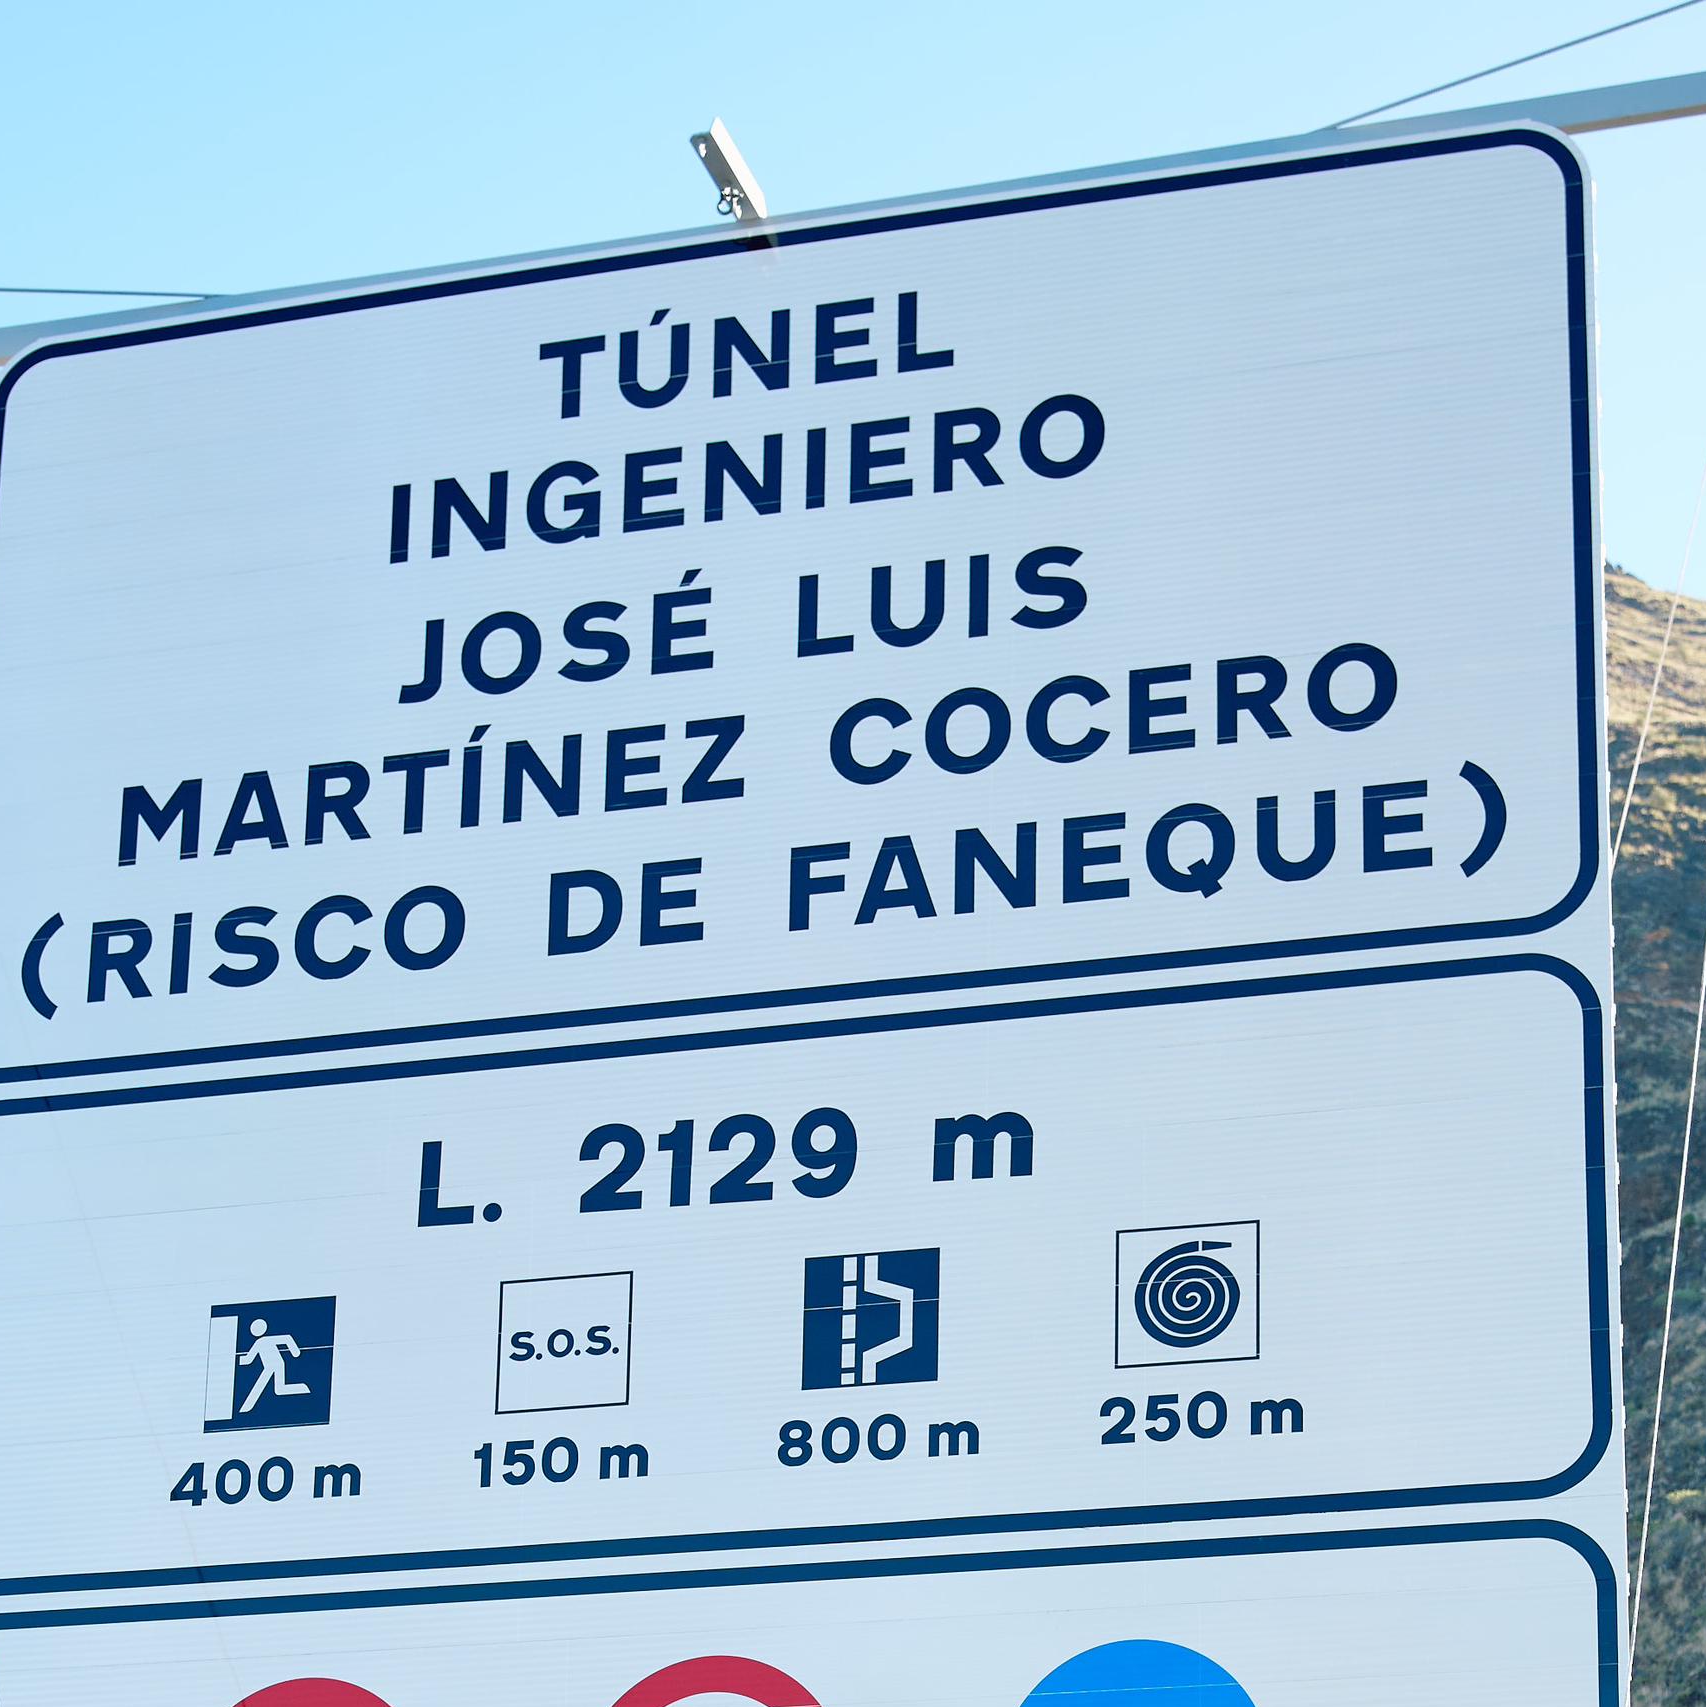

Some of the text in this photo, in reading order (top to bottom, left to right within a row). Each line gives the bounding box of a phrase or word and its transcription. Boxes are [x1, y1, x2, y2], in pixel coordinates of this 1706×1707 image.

[539, 290, 955, 420] TÚNEL
[389, 393, 1106, 565] INGENIERO
[397, 545, 1088, 705] JOSÉ LUIS
[117, 642, 1398, 868] MARTÍNEZ COCERO
[21, 759, 1507, 1021] (RISCO DE FANEQUE)
[417, 1106, 1034, 1228] L. 2129 m
[508, 1325, 621, 1362] S.O.S.
[473, 1436, 649, 1488] 150 m
[777, 1413, 980, 1467] 800 m
[1099, 1390, 1304, 1445] 250 m
[169, 1455, 362, 1507] 400 m
